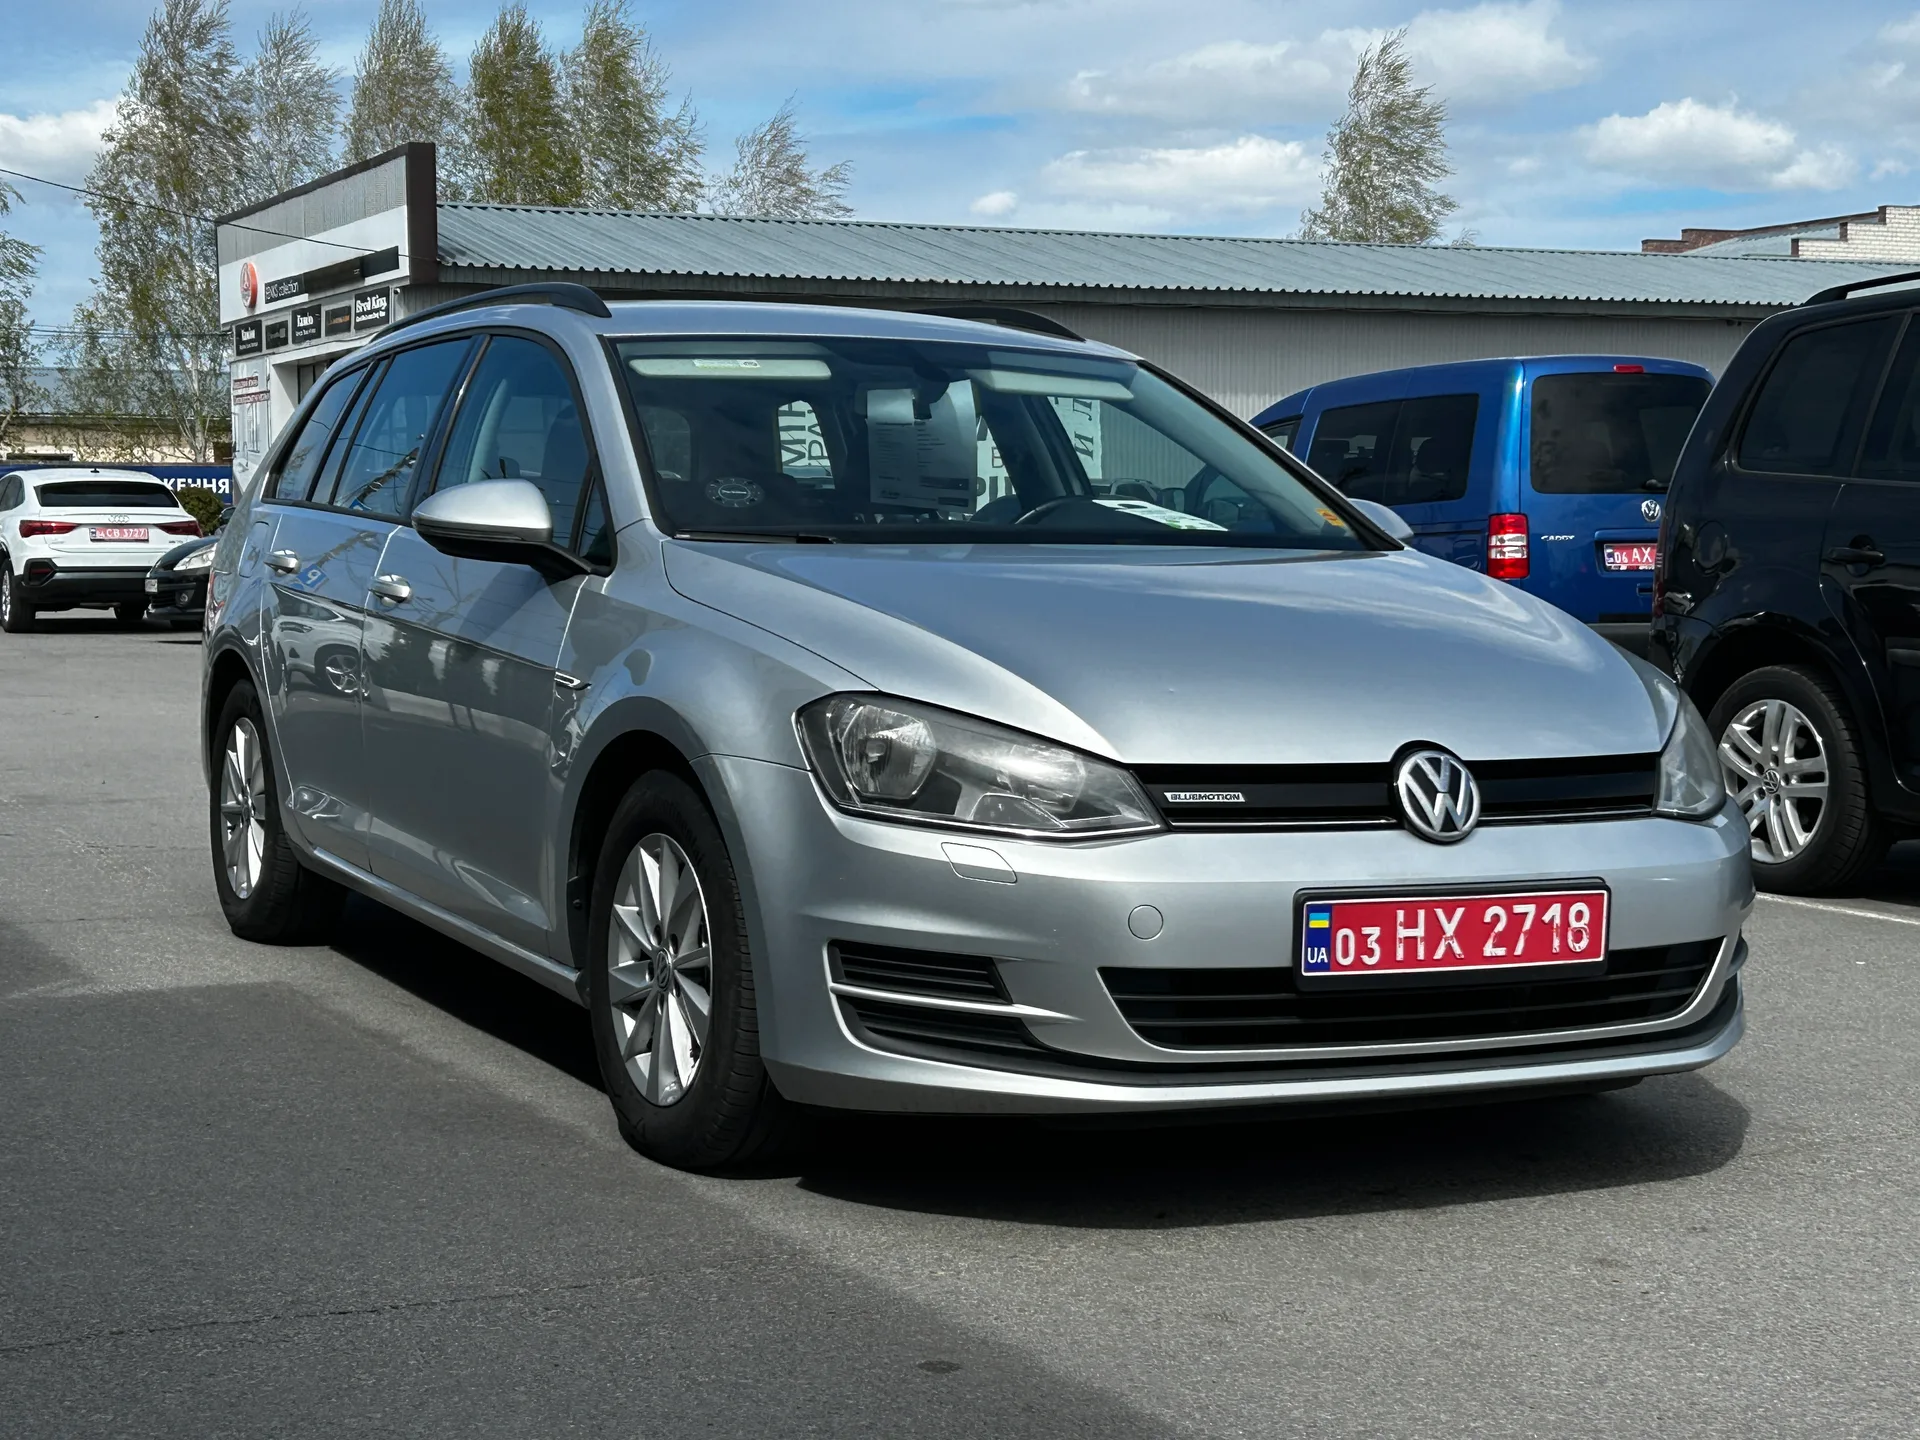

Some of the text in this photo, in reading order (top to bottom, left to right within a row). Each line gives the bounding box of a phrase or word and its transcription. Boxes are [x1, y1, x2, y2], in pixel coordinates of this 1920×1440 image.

[1614, 546, 1653, 564] 06 AX
[1170, 793, 1241, 801] BLUEMOTION
[1307, 901, 1591, 966] UA 03 HX 2718
